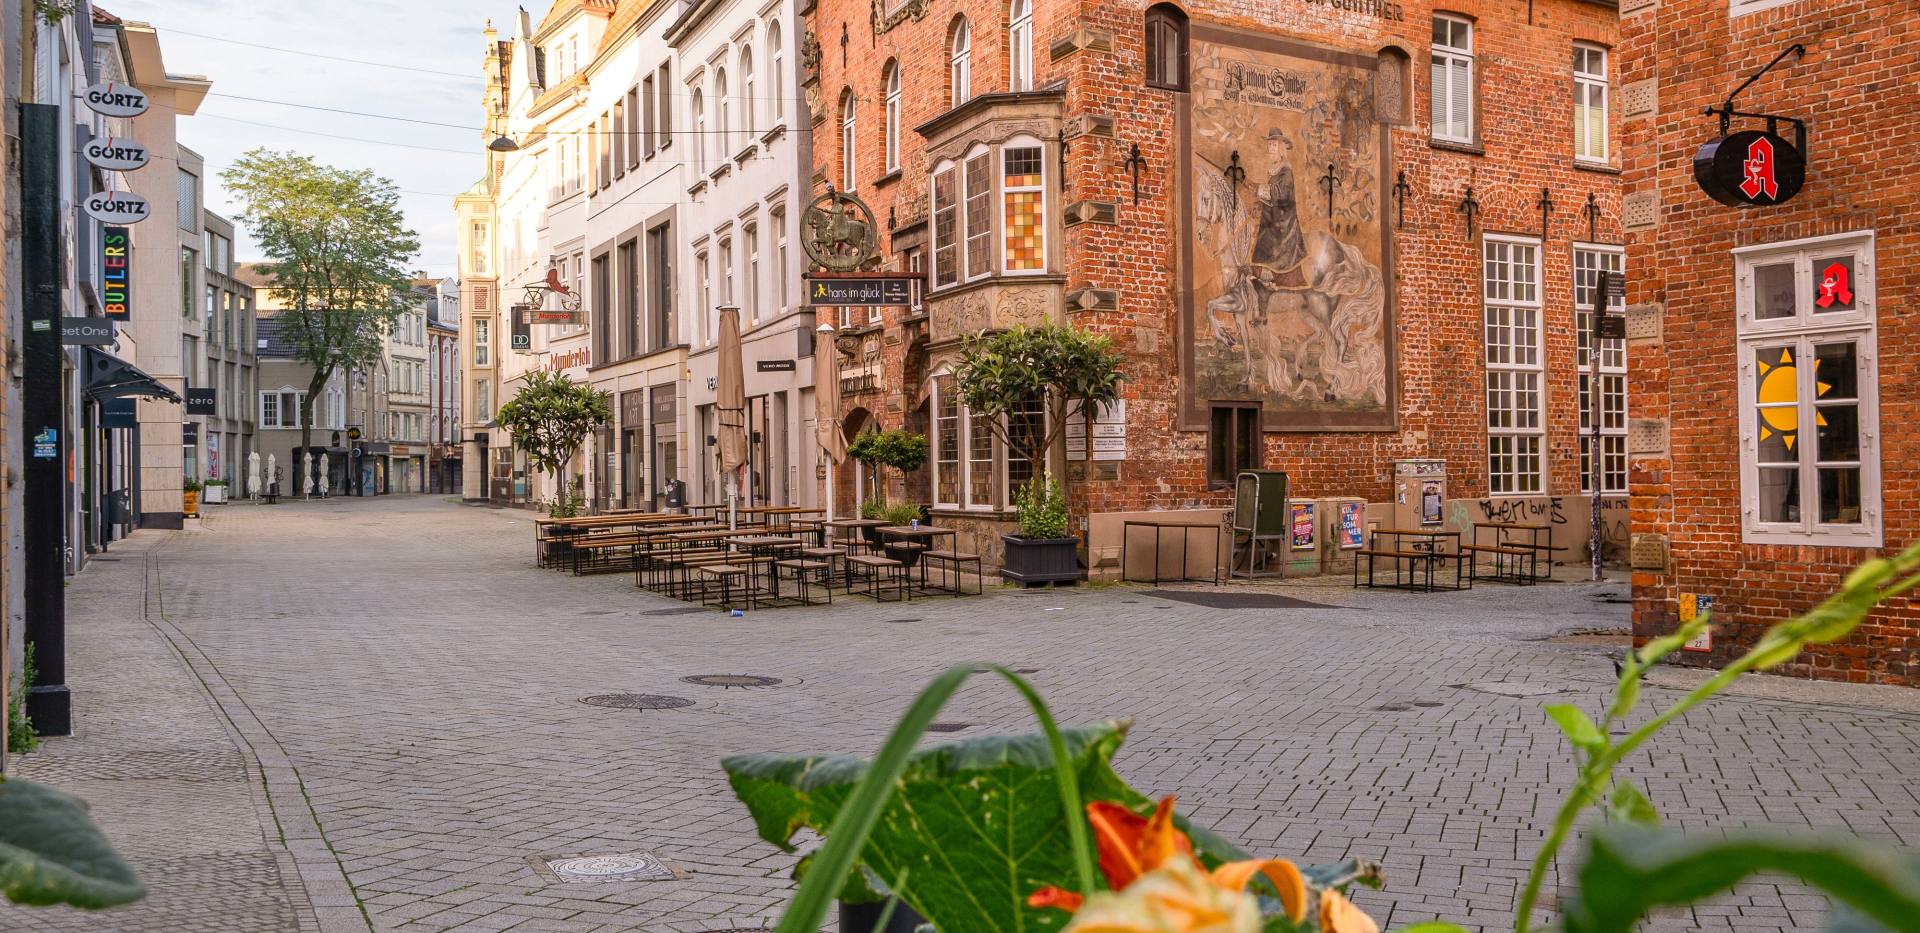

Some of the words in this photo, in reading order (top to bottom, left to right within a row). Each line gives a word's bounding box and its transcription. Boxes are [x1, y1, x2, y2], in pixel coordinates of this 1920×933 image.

[105, 235, 126, 313] BUTLERS
[828, 283, 847, 299] hans
[848, 287, 859, 298] im
[860, 283, 881, 302] glück
[81, 326, 109, 336] One
[550, 346, 591, 372] Munderloh
[189, 397, 214, 405] zero
[1341, 506, 1353, 514] KUL
[1346, 513, 1359, 521] TUR
[1342, 521, 1357, 529] SOM
[1348, 527, 1362, 535] MER
